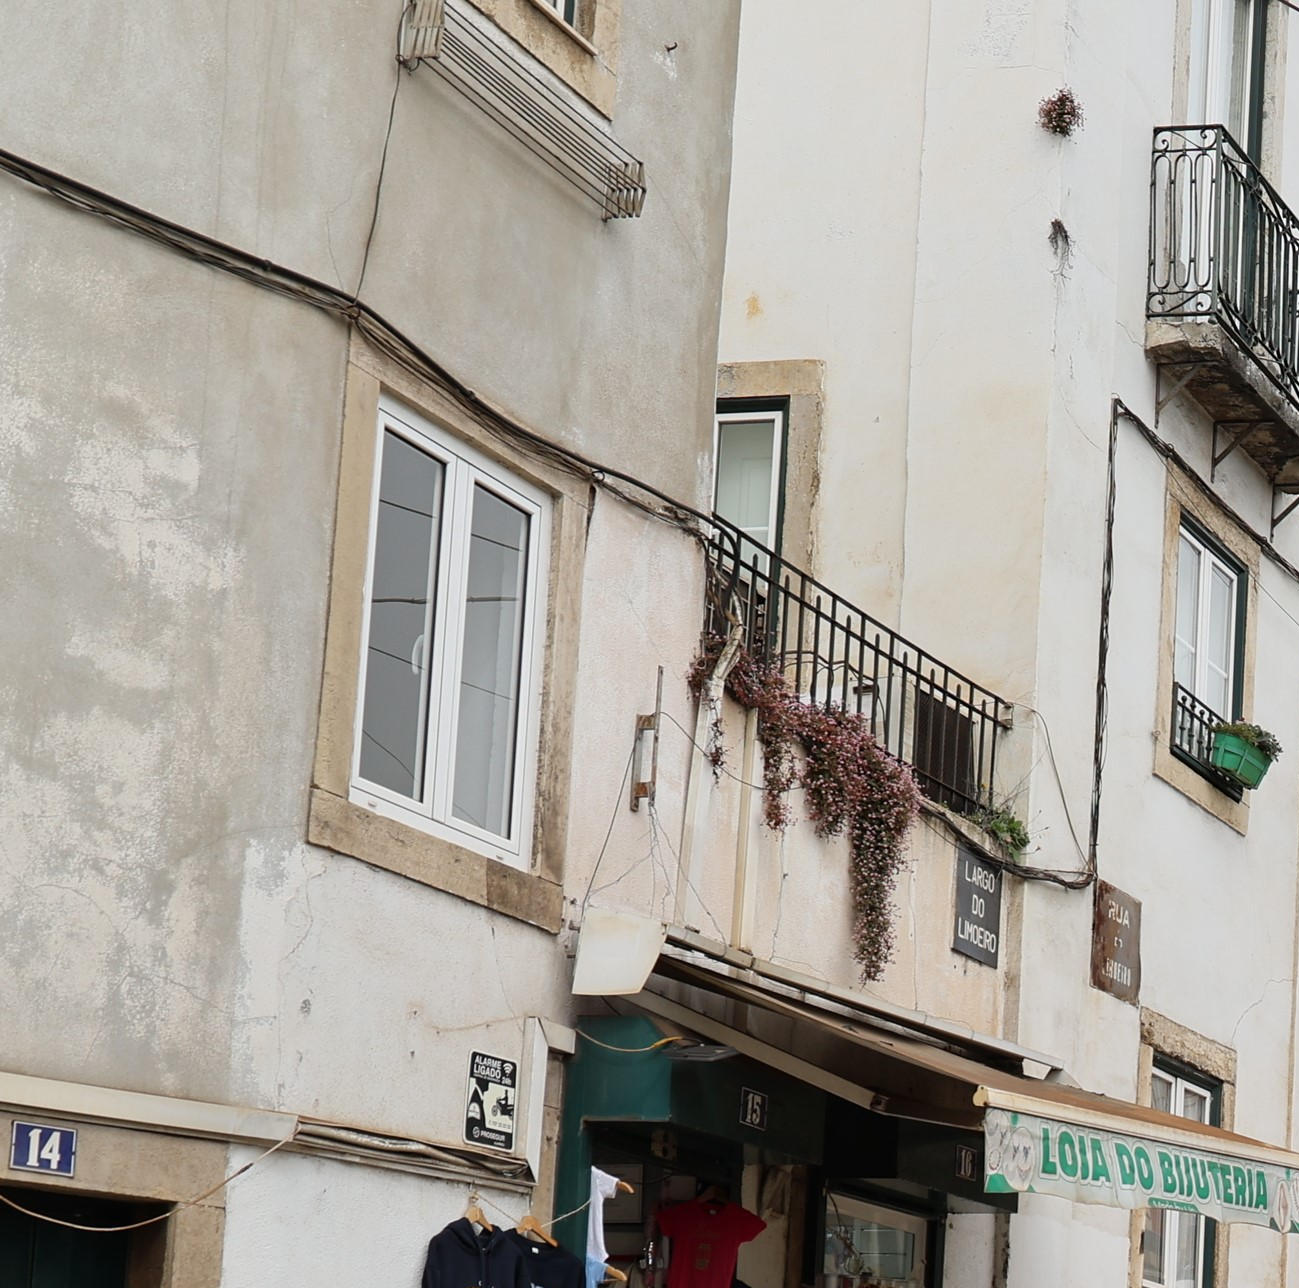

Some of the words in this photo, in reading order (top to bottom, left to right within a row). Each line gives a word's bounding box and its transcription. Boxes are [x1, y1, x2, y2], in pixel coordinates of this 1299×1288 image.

[965, 861, 995, 893] LARGO
[972, 894, 985, 918] DO
[1108, 900, 1130, 928] RUA
[958, 917, 997, 953] LIMOEIRO
[473, 1063, 501, 1080] LIGADO
[475, 1055, 502, 1070] ALARME
[745, 1092, 762, 1125] 15
[26, 1128, 61, 1170] 14
[960, 1149, 972, 1177] 16
[1040, 1127, 1111, 1183] LOJA
[1115, 1142, 1154, 1190] DO
[1157, 1151, 1269, 1212] BIJUTERIA
